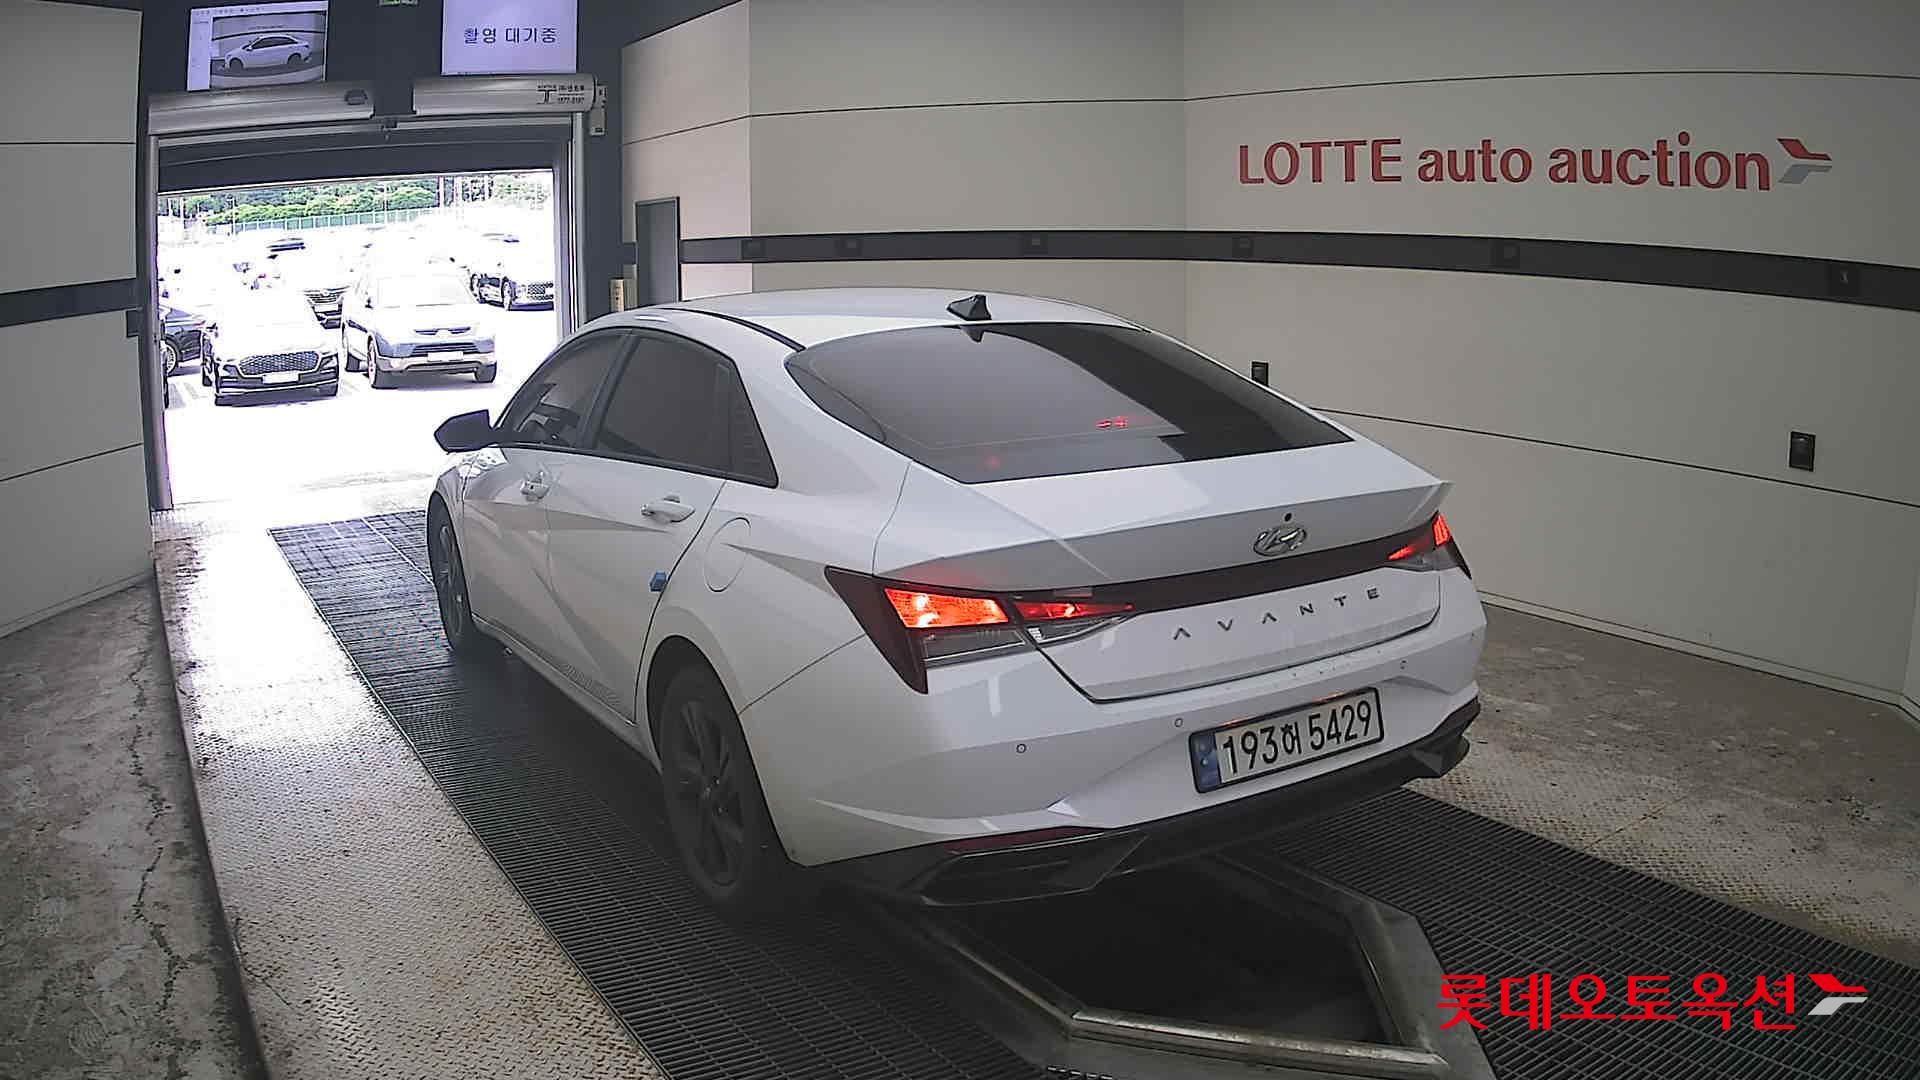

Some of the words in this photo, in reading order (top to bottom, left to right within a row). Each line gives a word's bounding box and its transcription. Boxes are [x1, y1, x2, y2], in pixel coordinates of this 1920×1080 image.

[505, 27, 557, 44] 대기중
[1238, 138, 1402, 185] LOTTE
[1417, 139, 1533, 184] auto
[1548, 131, 1771, 192] auction
[1173, 587, 1380, 641] AVANTE
[1222, 721, 1303, 775] 193허
[1308, 700, 1373, 752] 5429
